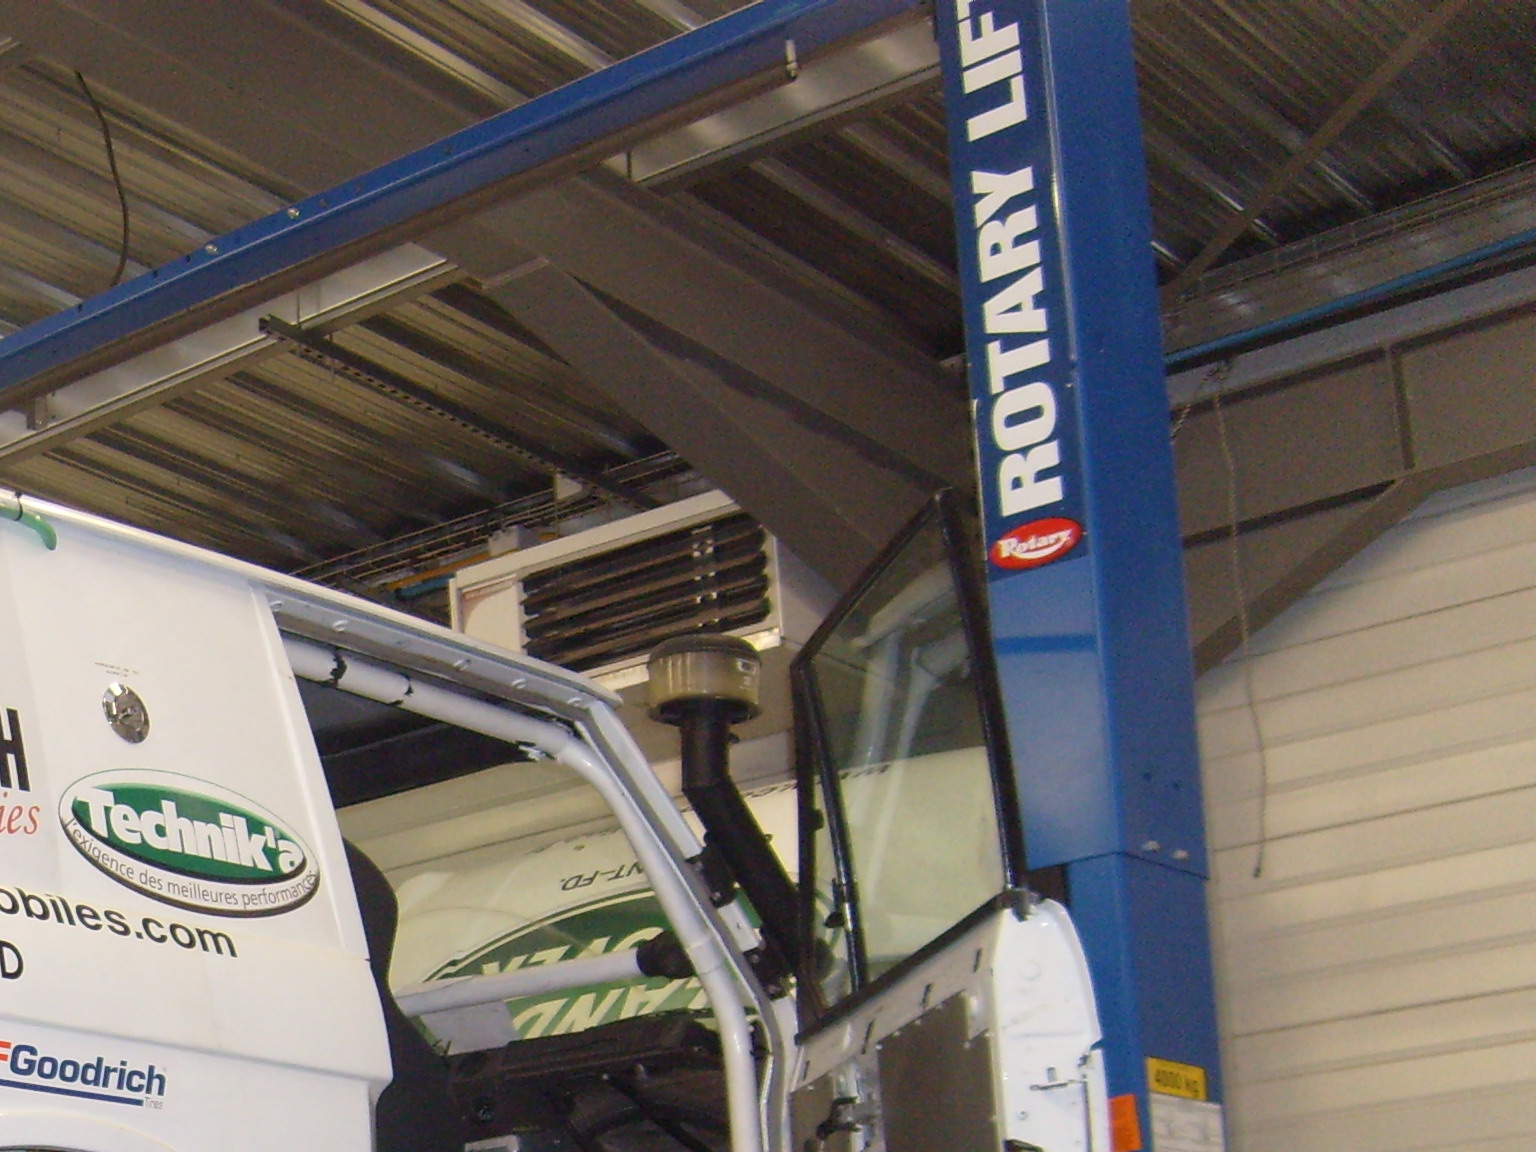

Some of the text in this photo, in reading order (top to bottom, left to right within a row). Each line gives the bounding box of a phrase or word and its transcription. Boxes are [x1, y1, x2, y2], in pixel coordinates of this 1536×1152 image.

[970, 165, 1064, 518] ROTARY
[997, 528, 1073, 559] Rotary
[139, 869, 163, 891] des
[167, 880, 239, 906] meilleures
[560, 861, 643, 892] NT-FD.
